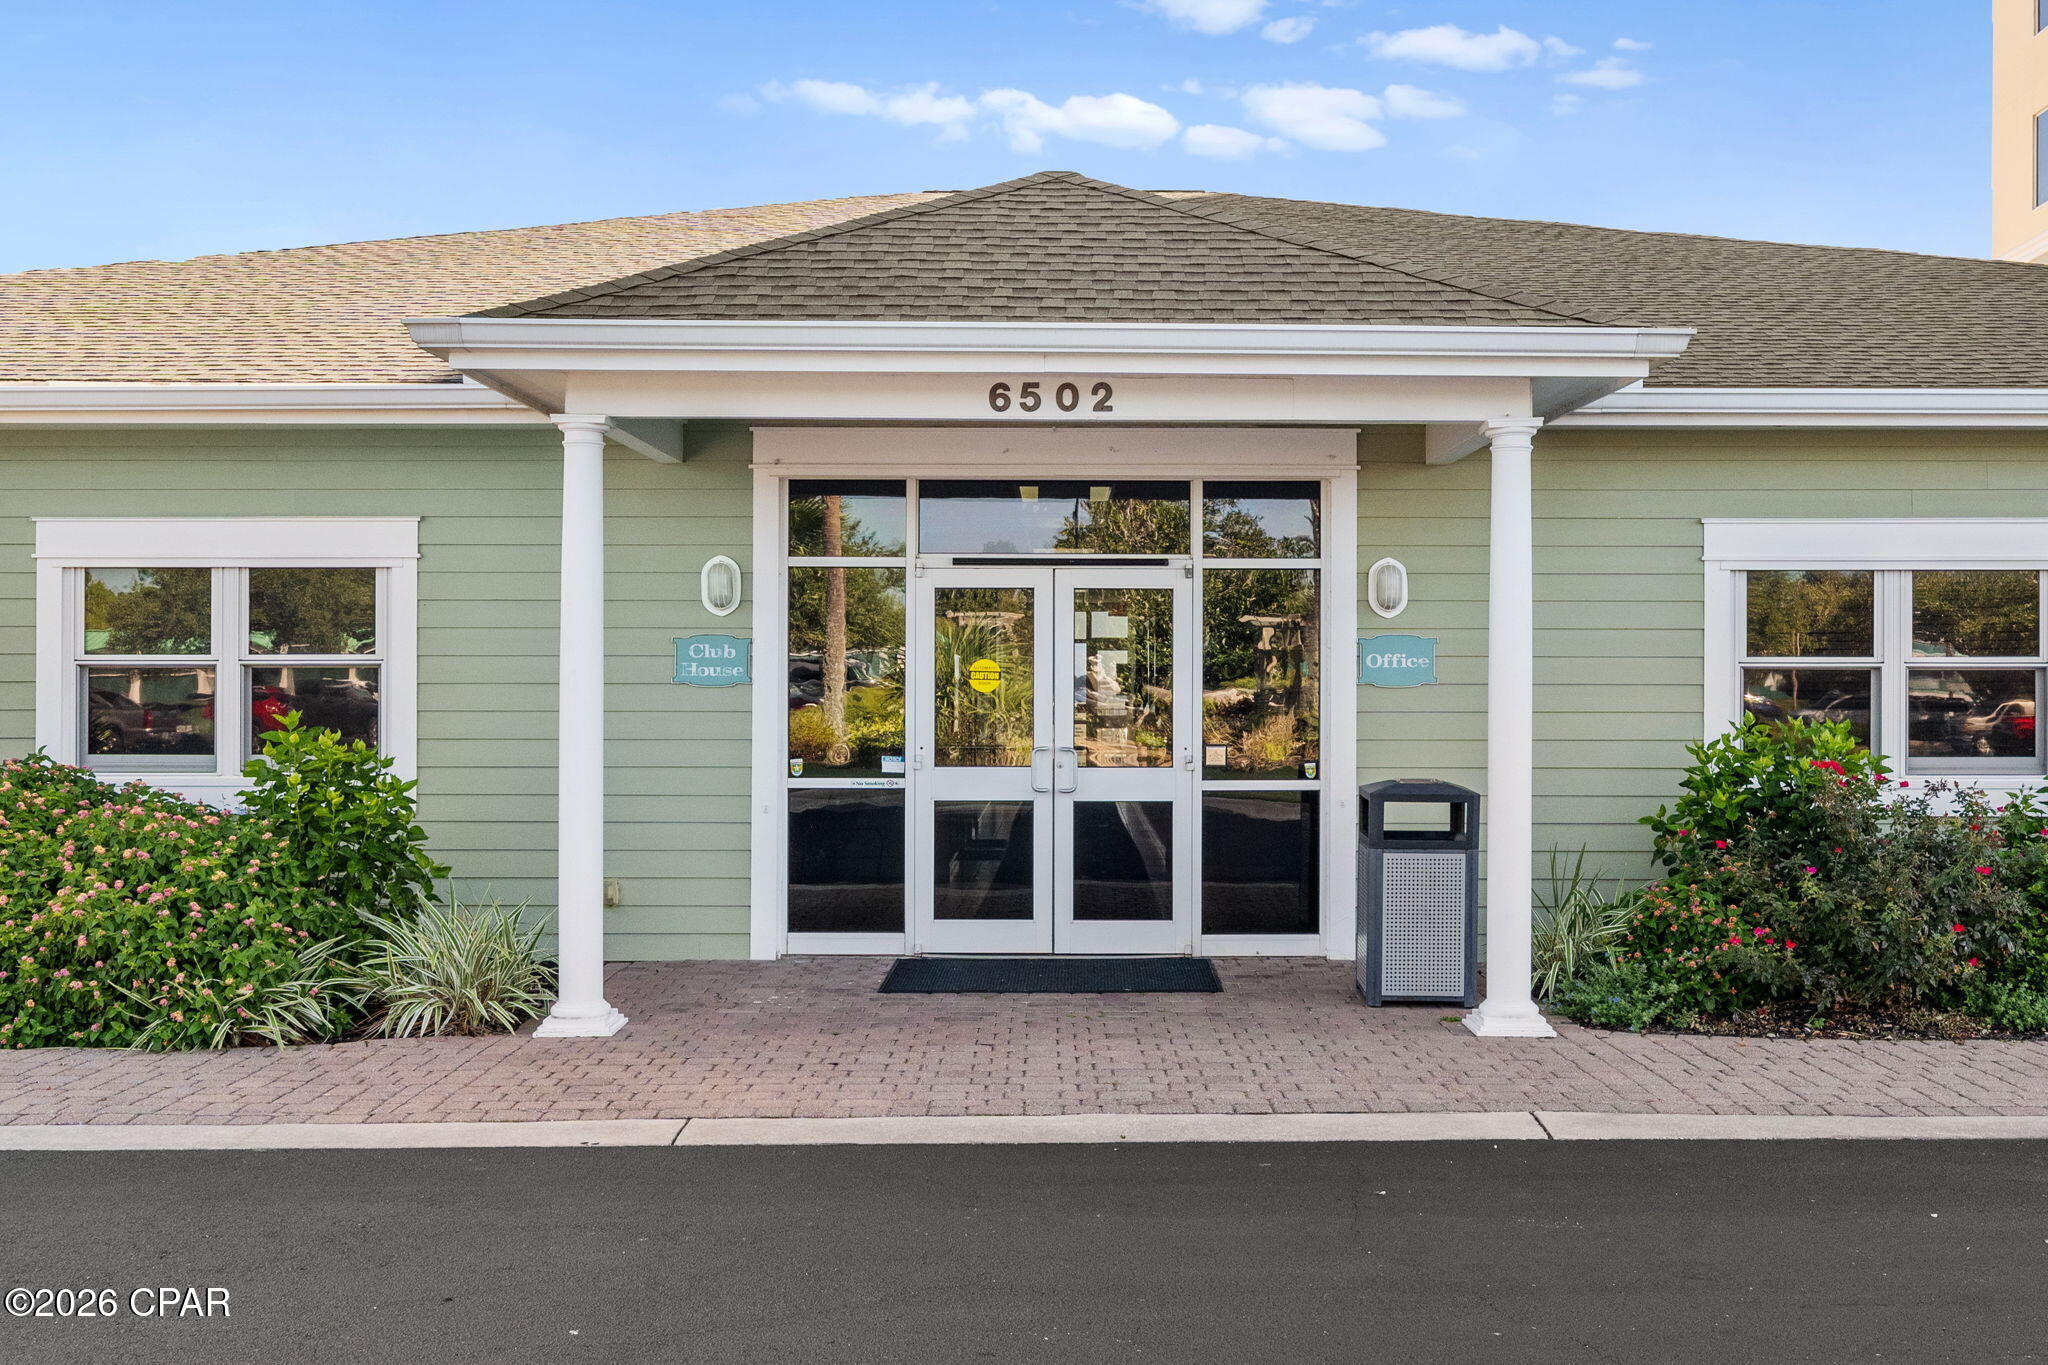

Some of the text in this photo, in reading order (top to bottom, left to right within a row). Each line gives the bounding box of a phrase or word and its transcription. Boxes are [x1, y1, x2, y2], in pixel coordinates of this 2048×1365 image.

[988, 381, 1113, 412] 6502
[689, 643, 736, 659] Club
[1366, 653, 1430, 669] Office
[681, 662, 744, 677] House
[970, 672, 999, 680] CAUTION
